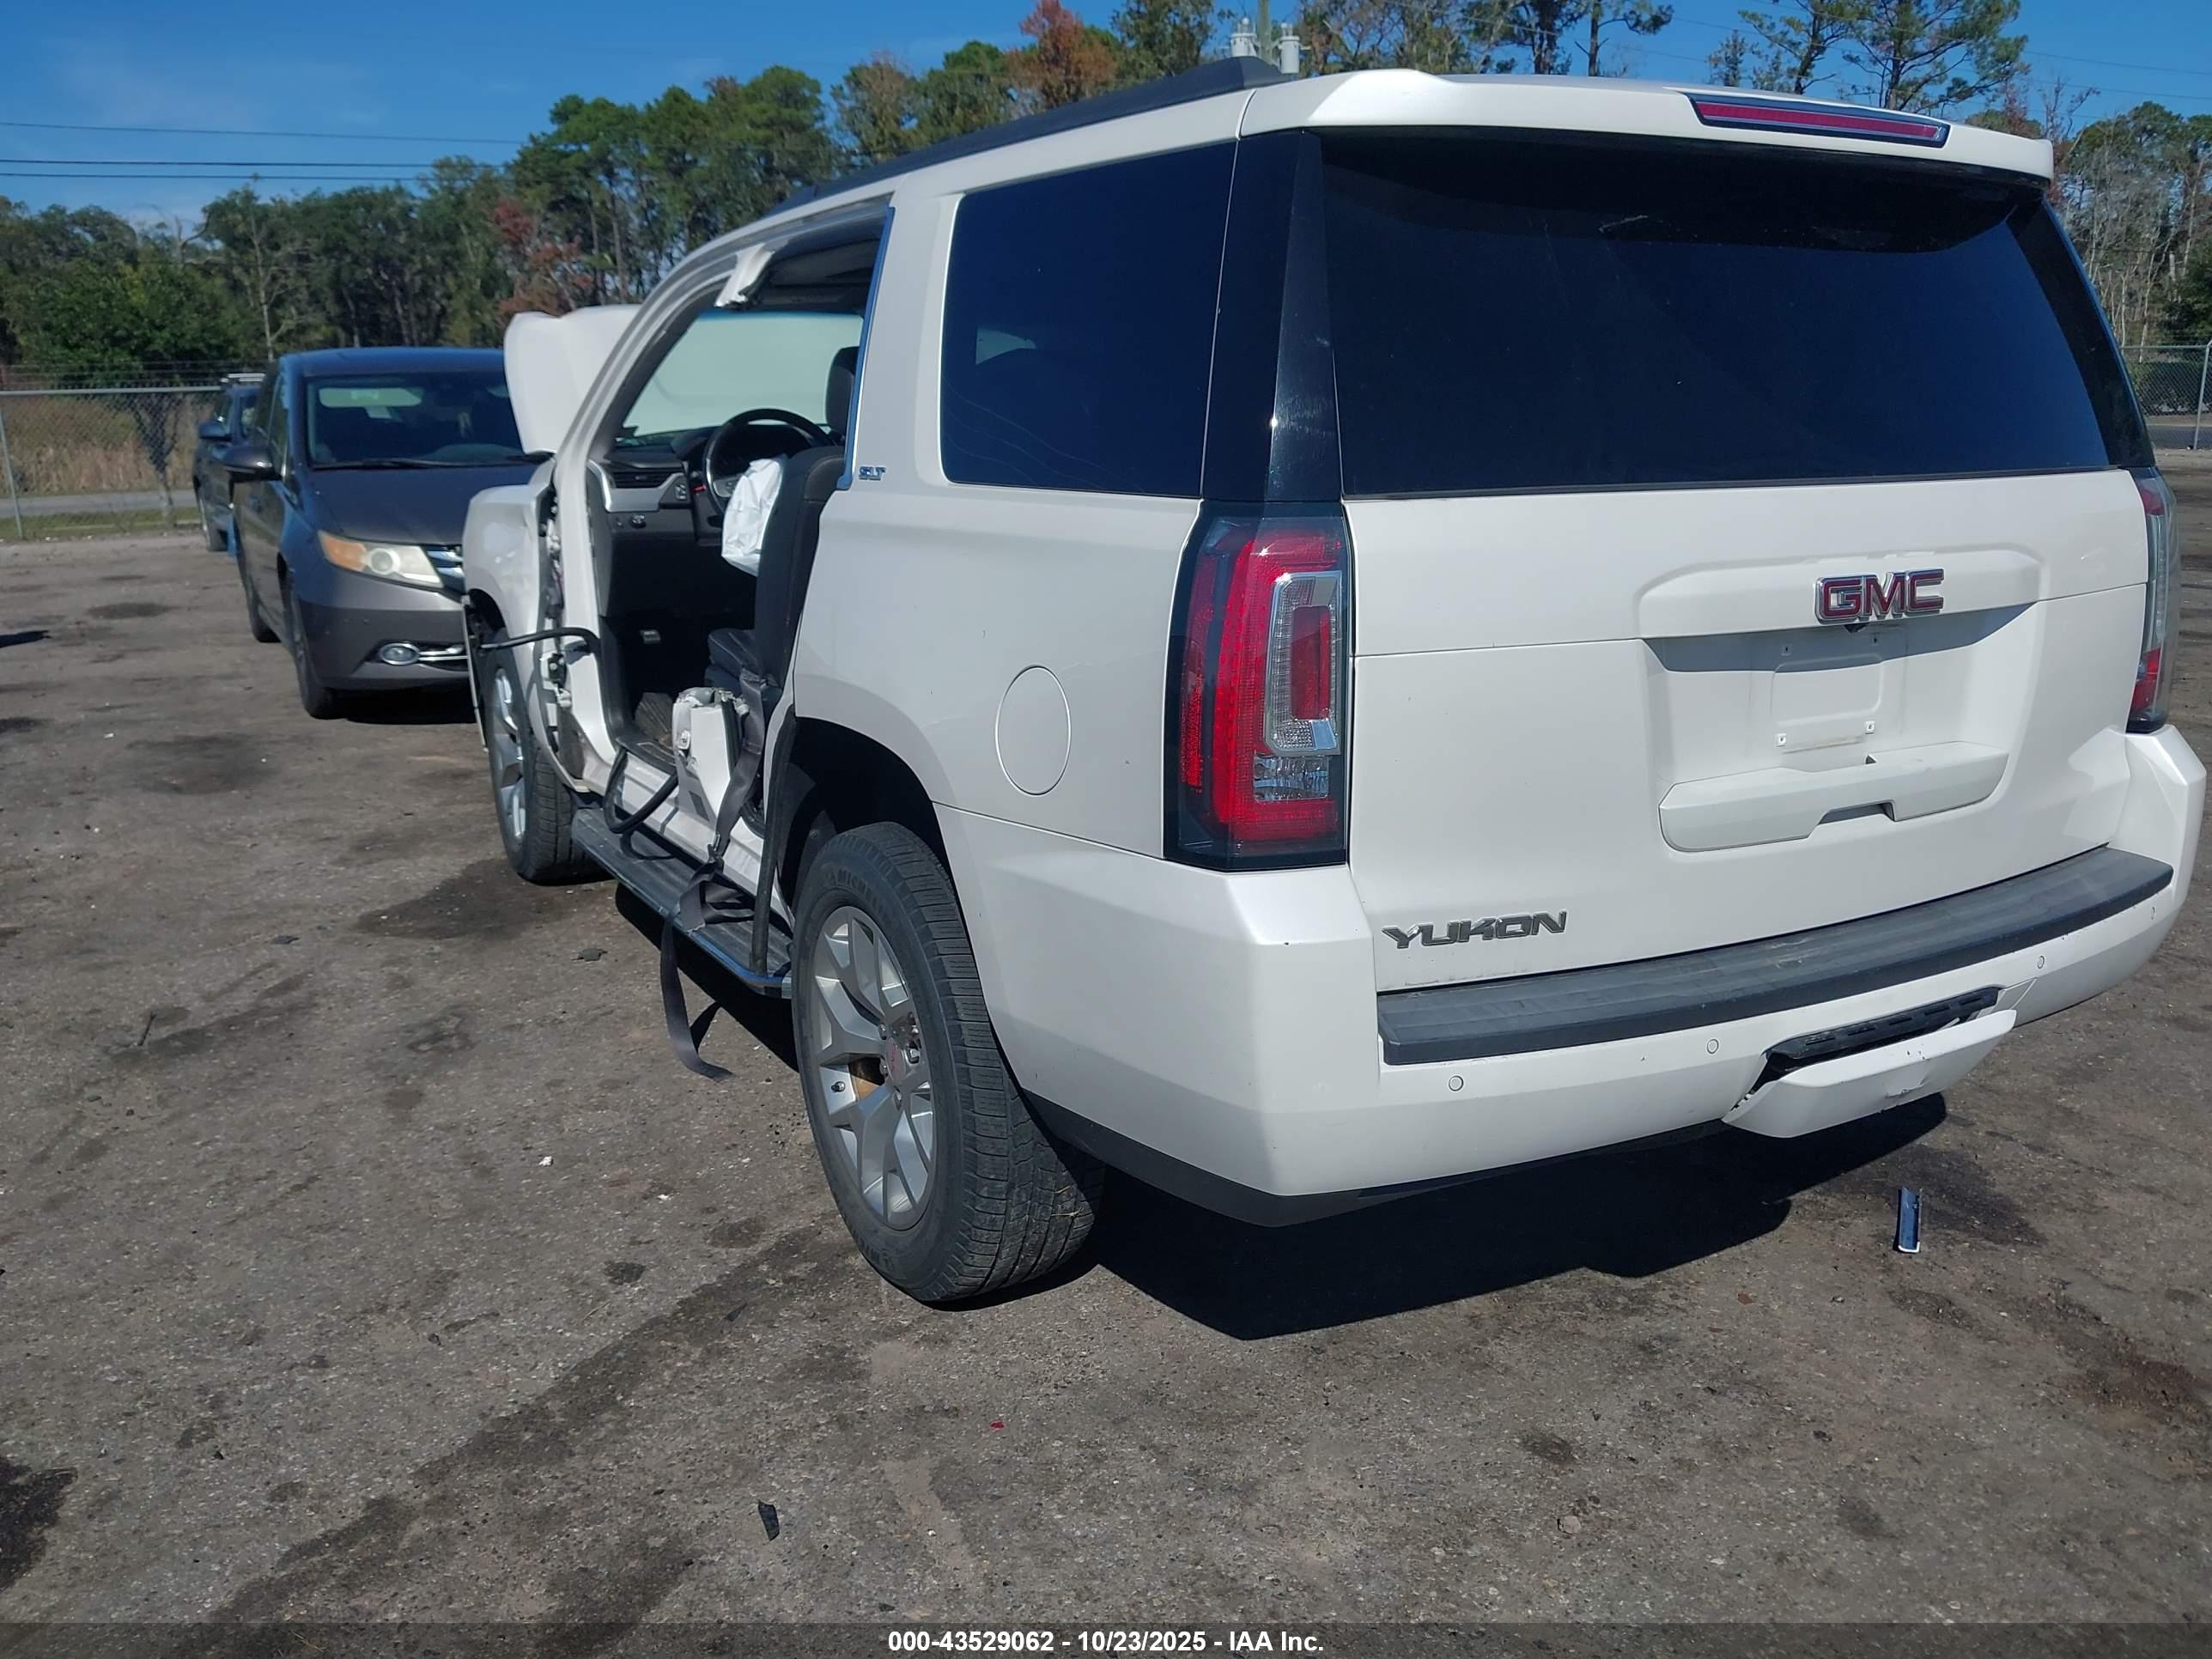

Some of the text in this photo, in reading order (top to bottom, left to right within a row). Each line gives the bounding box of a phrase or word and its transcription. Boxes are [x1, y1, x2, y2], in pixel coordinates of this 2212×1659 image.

[860, 466, 886, 481] SLT
[1814, 568, 1944, 624] GMC
[1382, 911, 1567, 949] YUKON
